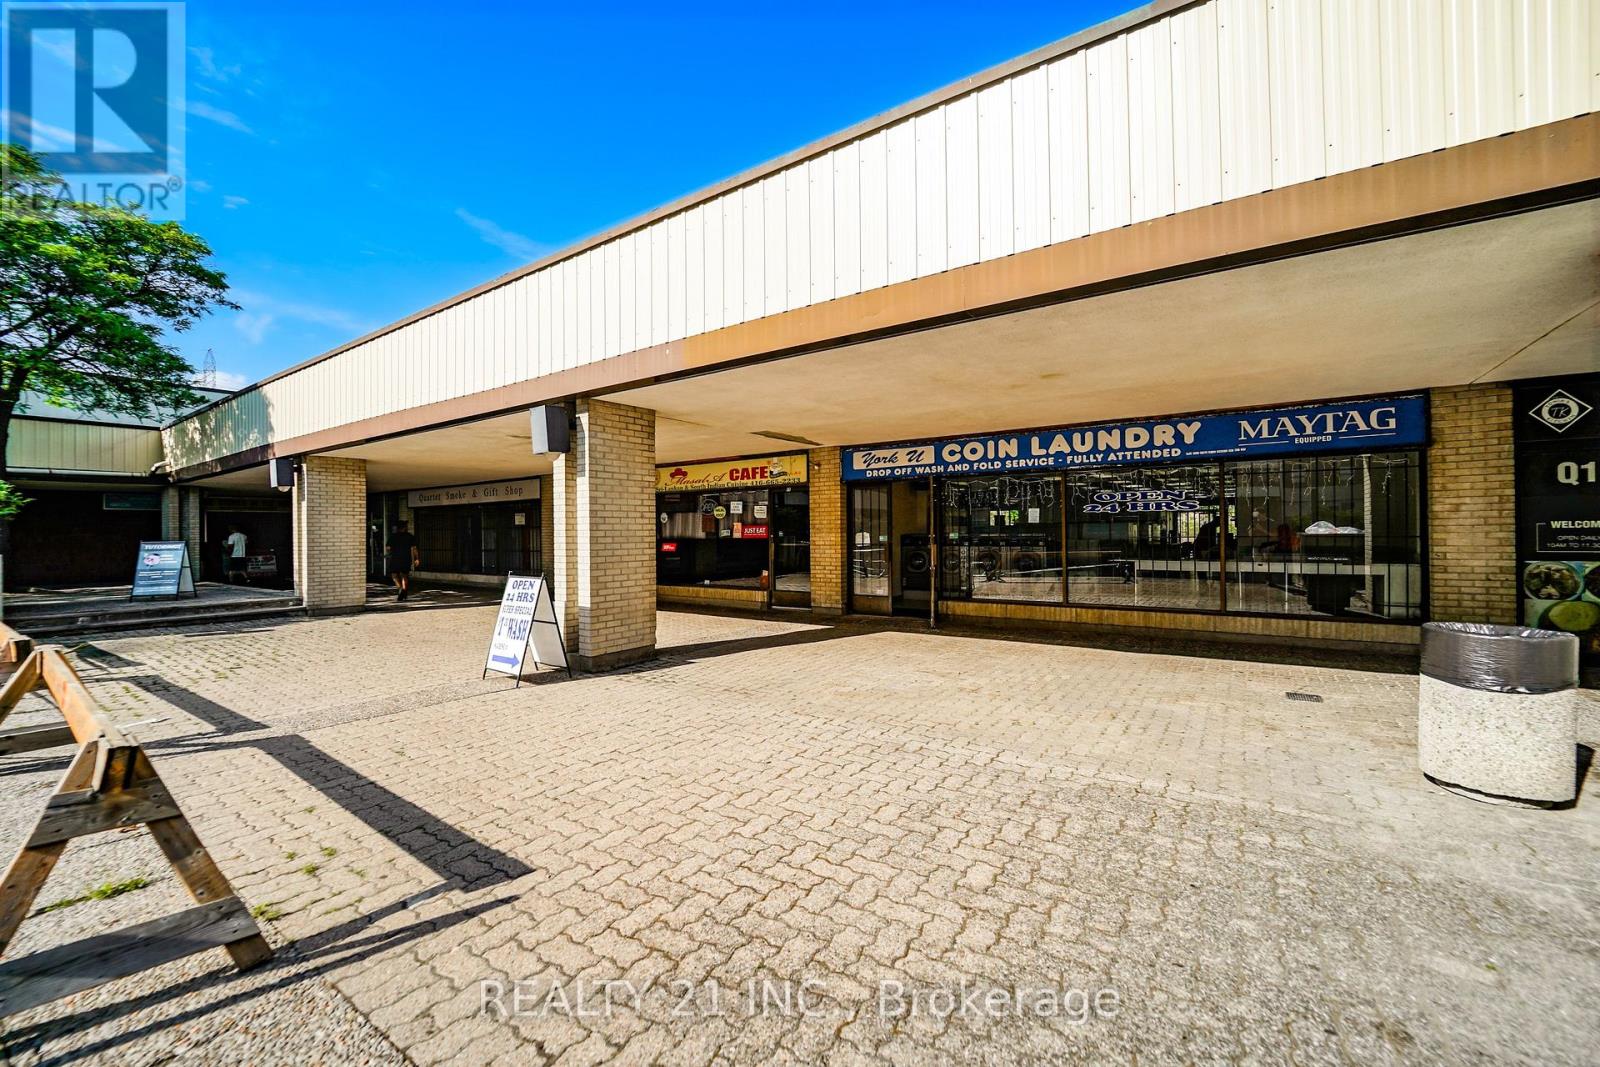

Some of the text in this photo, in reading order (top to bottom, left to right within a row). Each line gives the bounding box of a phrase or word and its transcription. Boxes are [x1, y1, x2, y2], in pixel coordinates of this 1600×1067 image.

[1238, 407, 1397, 440] MAYTAG
[861, 452, 900, 468] York
[906, 449, 925, 463] U
[941, 438, 1018, 463] COIN
[1031, 421, 1201, 456] LAUNDRY
[1294, 435, 1332, 444] EQUIPPED
[866, 470, 892, 478] DROP
[896, 468, 912, 476] OFF
[915, 466, 944, 474] WASH
[947, 464, 970, 472] AND
[973, 461, 1002, 470] FOLD
[1005, 456, 1055, 468] SERVICE
[1066, 453, 1104, 464] FULLY
[1107, 448, 1182, 461] ATTENDED
[729, 466, 769, 481] CAFE
[1557, 461, 1596, 485] Q1
[446, 490, 466, 500] Smoke
[471, 489, 477, 497] &
[484, 487, 499, 497] Gift
[505, 485, 523, 497] Shop
[1094, 490, 1186, 502] OPEN
[1083, 500, 1200, 513] 24 HRS
[512, 580, 536, 590] OPEN
[516, 592, 535, 603] HRS
[508, 618, 529, 640] WASH
